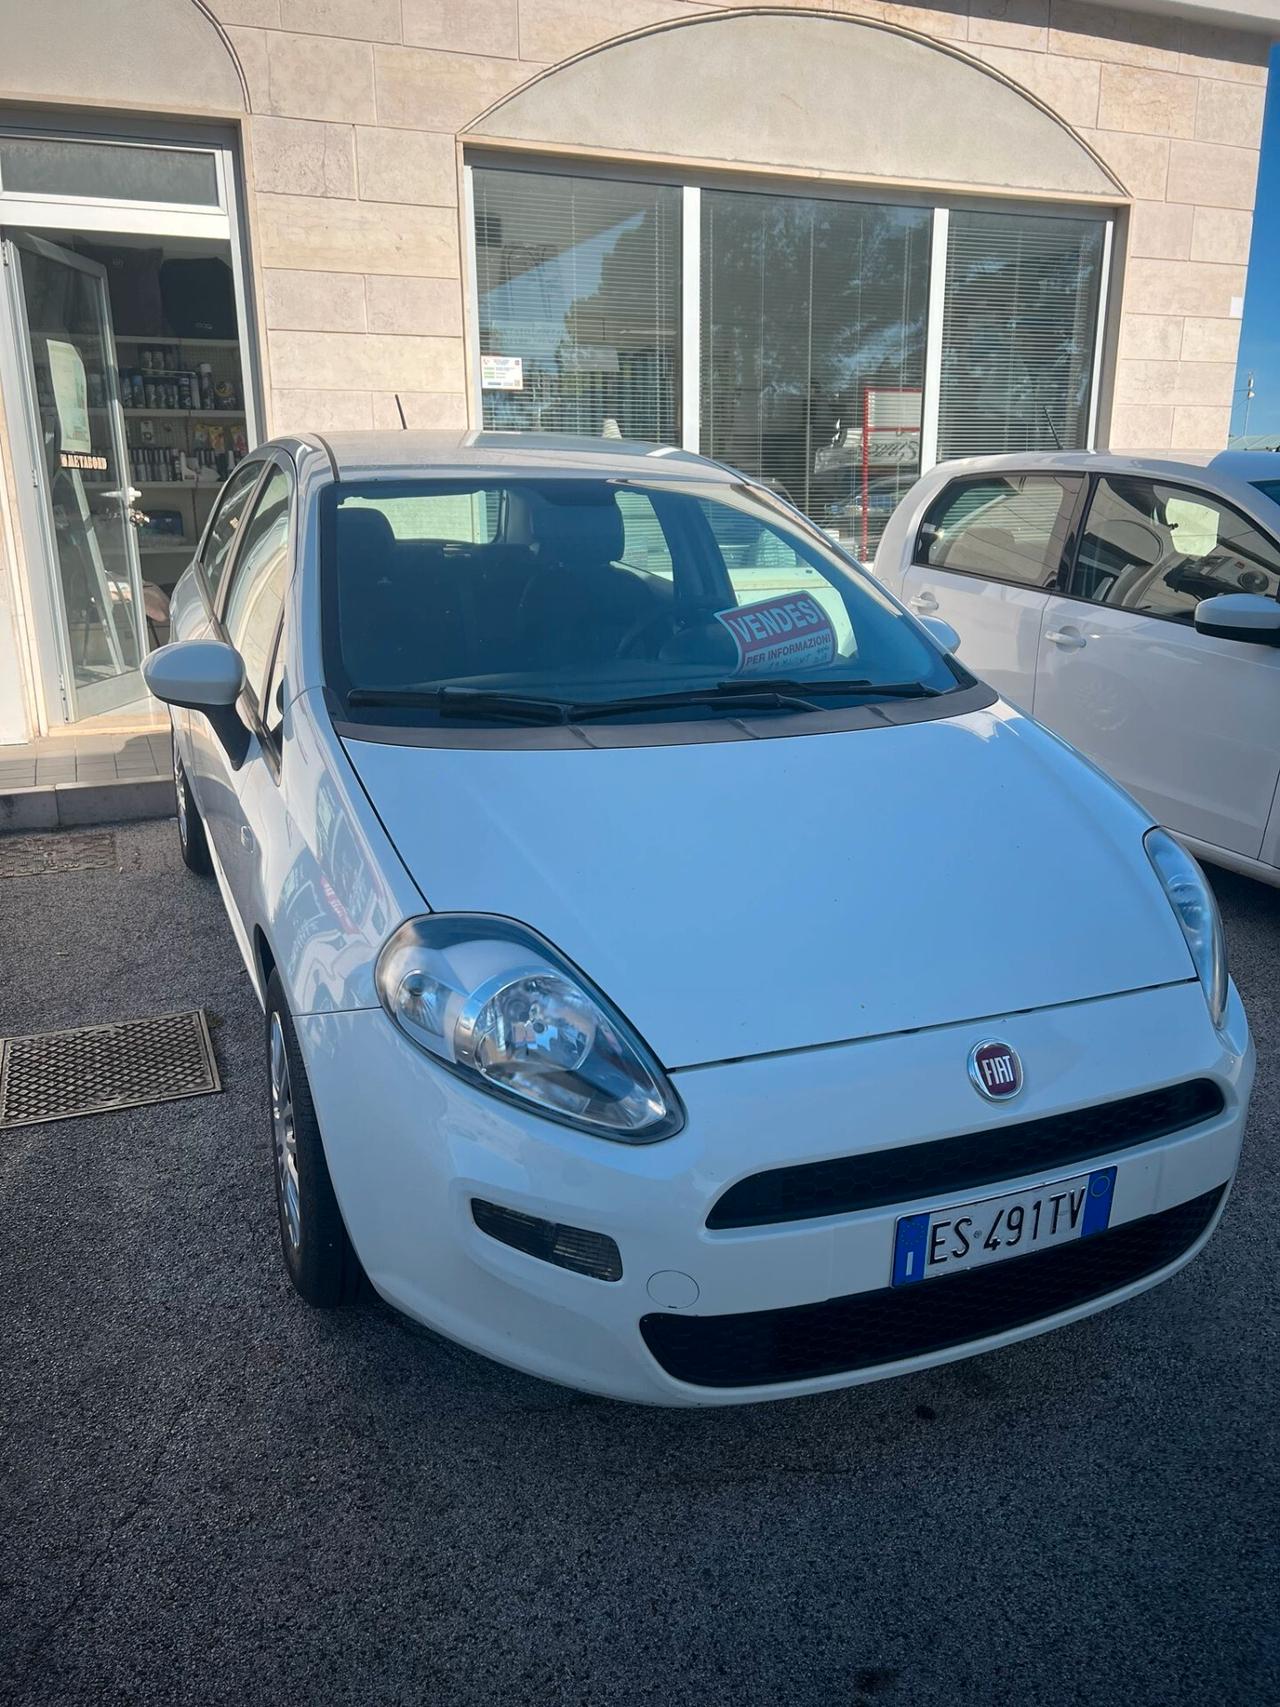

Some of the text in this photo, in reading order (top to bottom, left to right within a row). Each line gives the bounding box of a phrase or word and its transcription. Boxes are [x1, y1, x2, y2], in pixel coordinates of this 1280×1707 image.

[745, 654, 766, 666] PER
[767, 633, 831, 660] INFORMAZIONI
[981, 1055, 1014, 1086] FIAT
